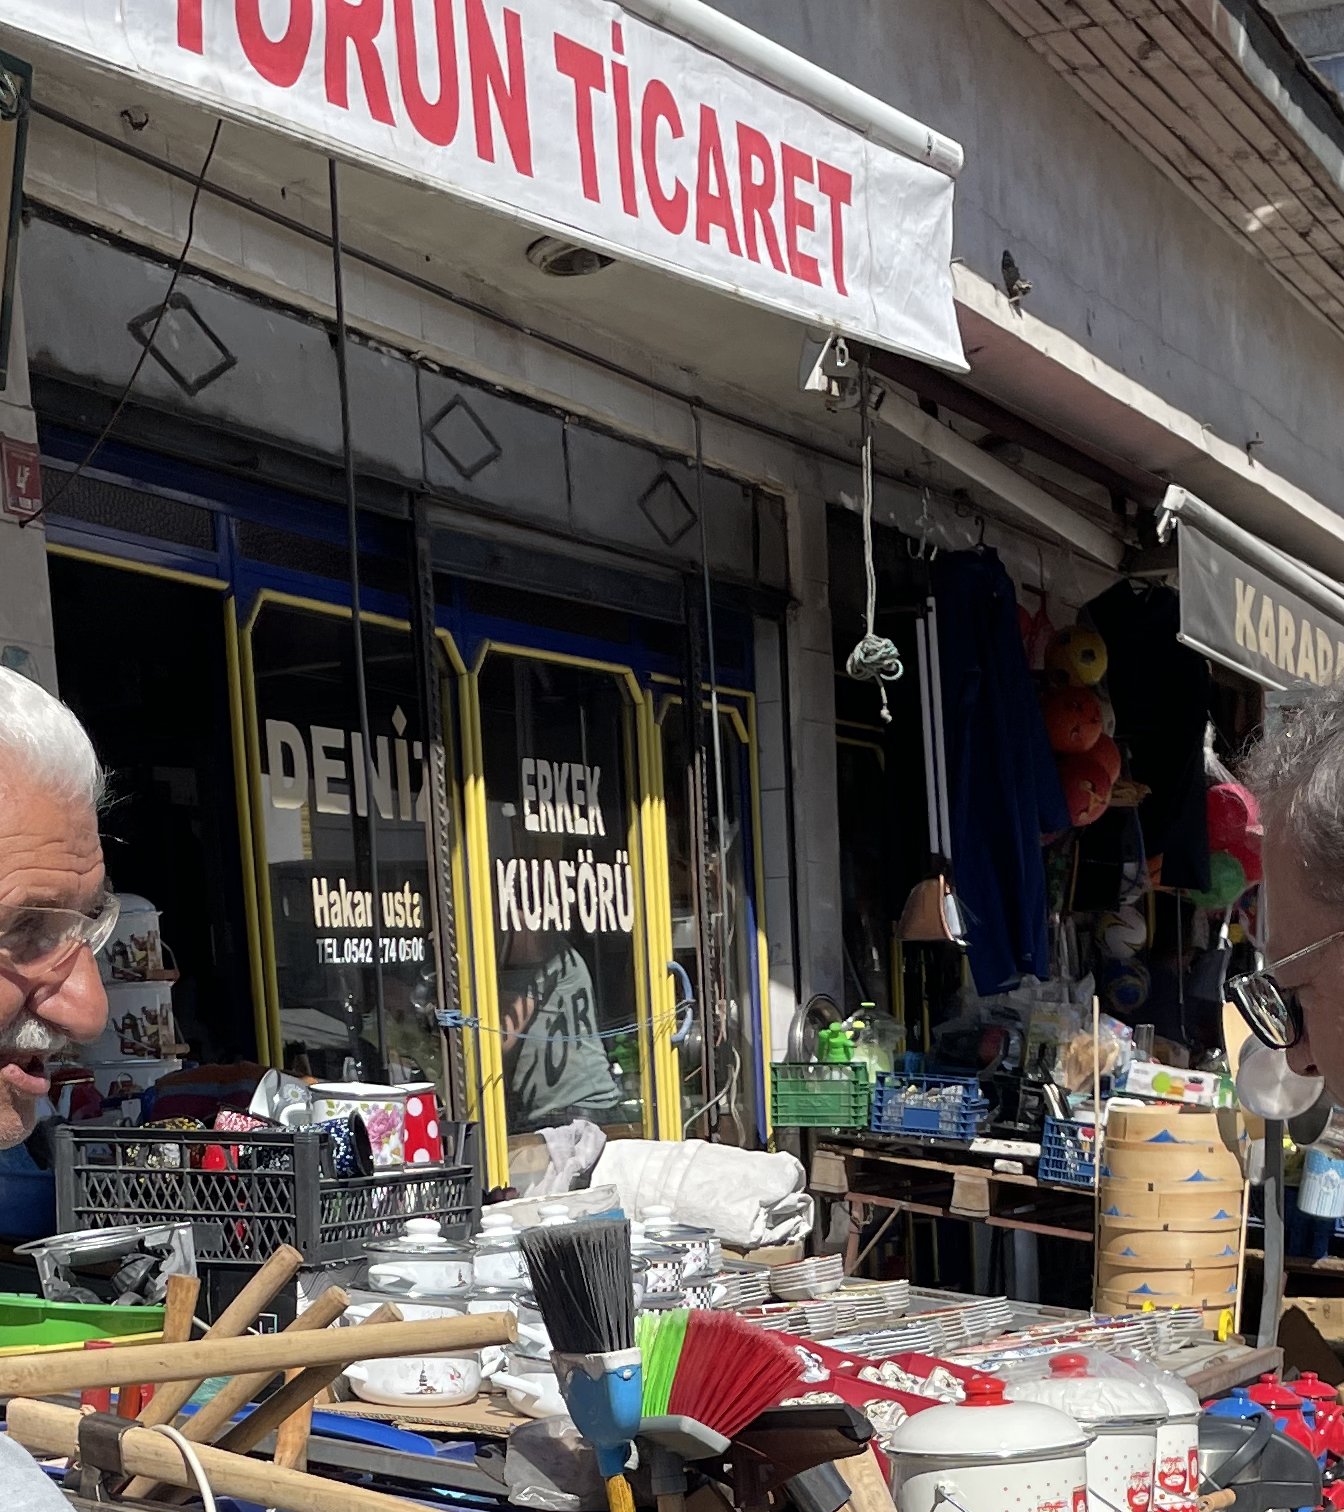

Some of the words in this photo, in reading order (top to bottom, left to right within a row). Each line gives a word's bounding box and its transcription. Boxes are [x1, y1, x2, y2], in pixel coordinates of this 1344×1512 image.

[177, 0, 534, 179] ORUN
[553, 19, 852, 296] TİCARET
[521, 757, 606, 837] ERKEK
[381, 881, 425, 928] usta
[496, 849, 634, 933] KUAFÖRÜ
